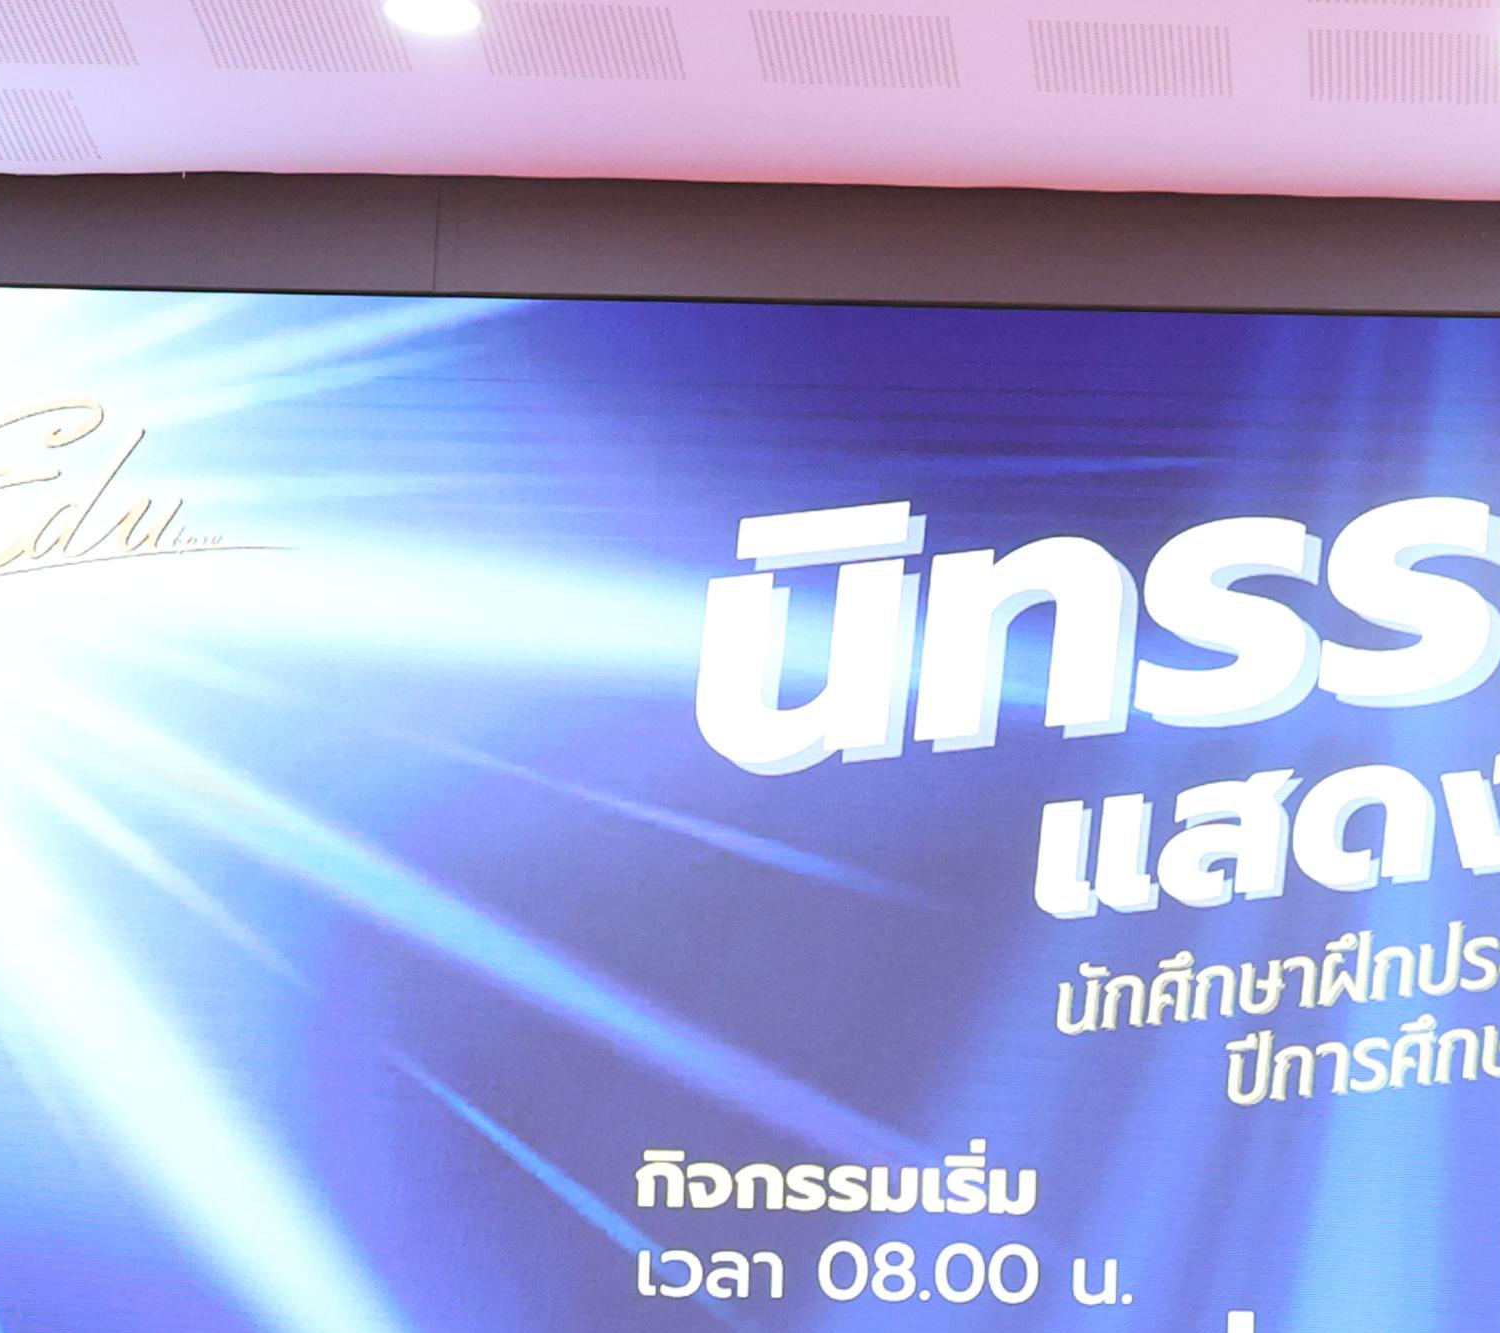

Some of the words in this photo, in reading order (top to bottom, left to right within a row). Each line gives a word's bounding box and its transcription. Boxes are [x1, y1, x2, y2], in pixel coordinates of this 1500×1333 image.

[634, 1138, 1038, 1215] กิจกรรมเริ่ม
[637, 1249, 784, 1299] เวลา
[817, 1241, 1040, 1304] 08.00
[1072, 1257, 1134, 1306] น.
